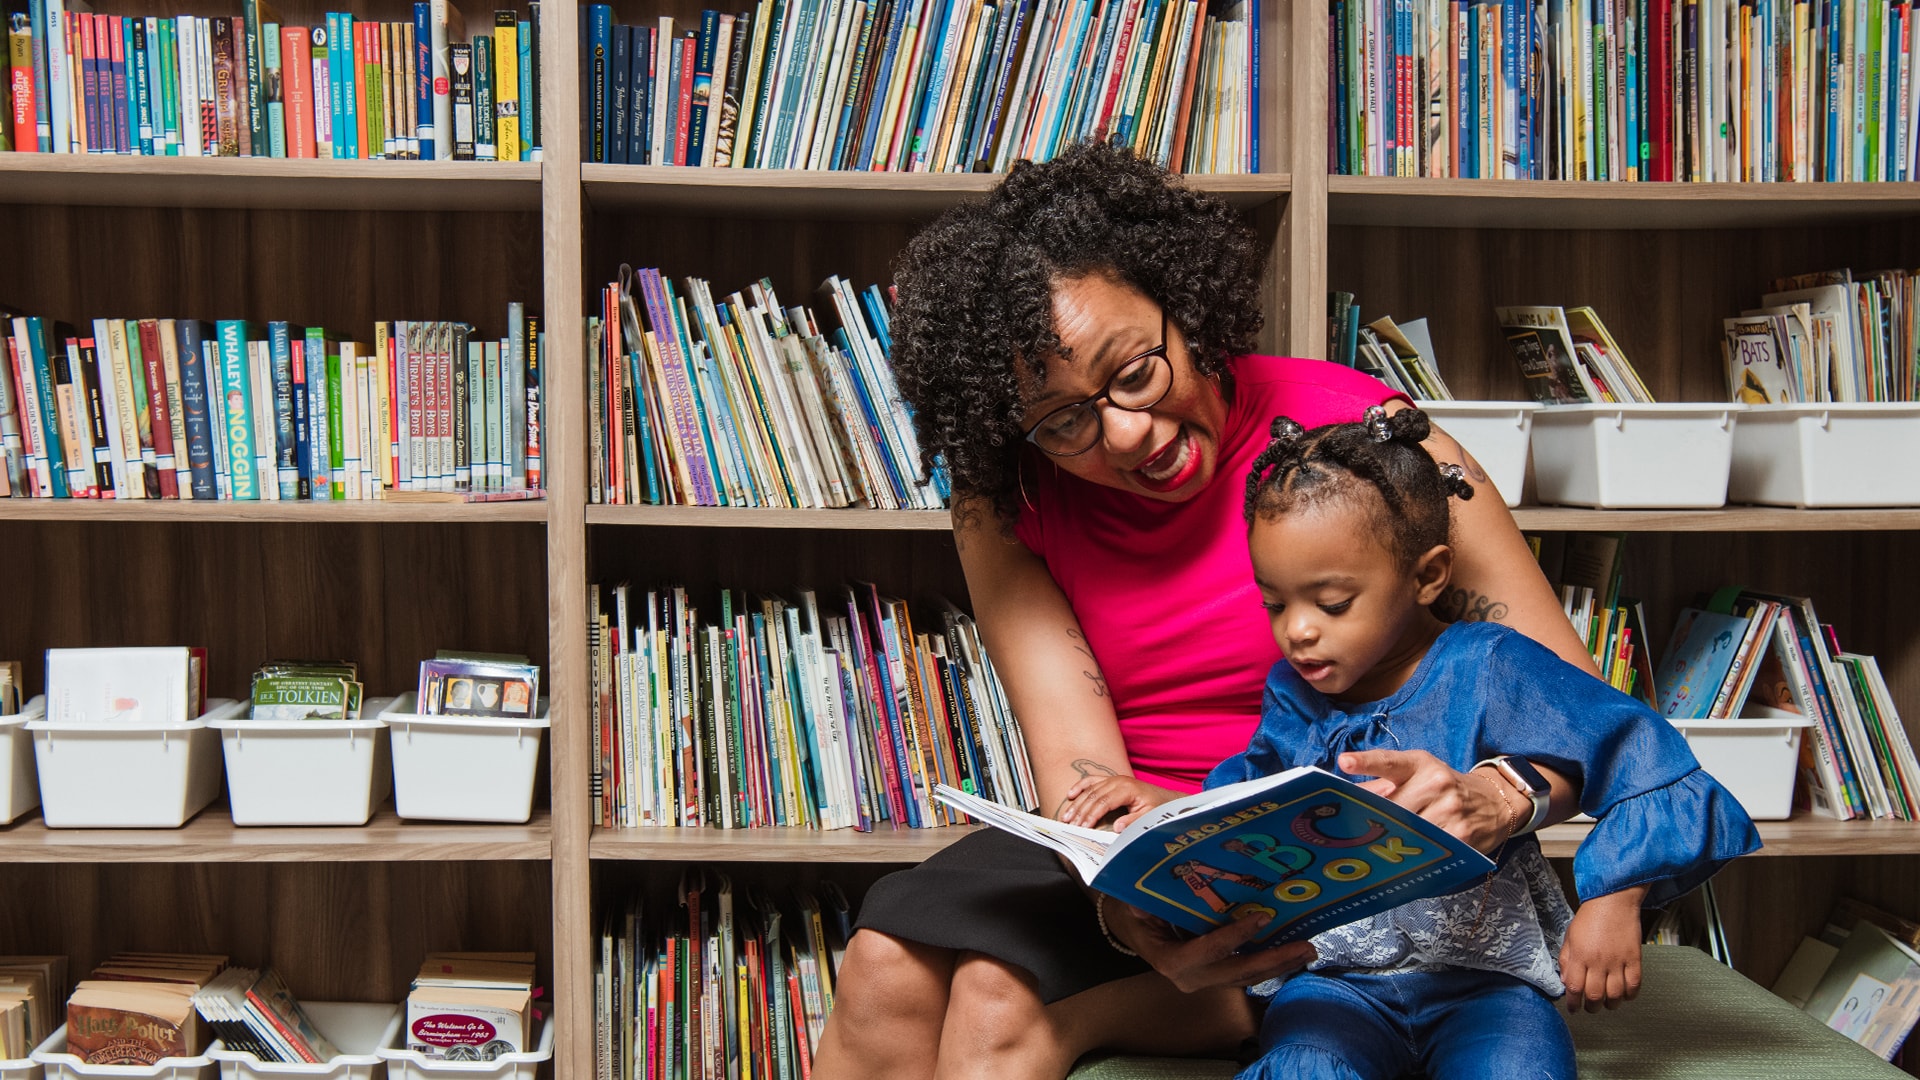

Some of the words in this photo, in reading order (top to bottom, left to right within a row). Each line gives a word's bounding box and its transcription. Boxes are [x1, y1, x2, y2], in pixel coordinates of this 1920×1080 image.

[17, 38, 27, 57] Ryan
[247, 34, 256, 56] Down
[735, 29, 747, 48] The
[860, 25, 872, 48] NOT
[1508, 33, 1514, 45] ON
[249, 59, 257, 67] in
[418, 42, 429, 71] Maniac
[730, 51, 742, 80] Giver
[86, 72, 95, 97] HOLES
[100, 71, 109, 96] HOLES
[115, 75, 124, 100] HOLES
[217, 70, 230, 112] GRIMM
[13, 70, 27, 124] augustine
[139, 89, 147, 105] TELL
[332, 82, 340, 115] STARGIRL
[345, 82, 353, 115] STARGIRL
[615, 86, 625, 109] Johnny
[633, 88, 643, 110] Johnny
[252, 109, 262, 132] Woods
[616, 110, 625, 134] Tremain
[634, 111, 643, 136] Tremain
[695, 109, 703, 125] JOAN
[271, 109, 280, 156] HORSERADIS
[275, 328, 287, 353] MAMA
[378, 328, 386, 348] Wilson
[529, 321, 537, 338] PAUL
[224, 325, 242, 389] WHALEY
[529, 342, 537, 369] ZINDEL
[658, 341, 671, 366] MISS
[1740, 339, 1770, 366] BATS
[25, 382, 34, 395] THE
[148, 361, 157, 390] Because
[153, 392, 161, 405] We
[277, 381, 289, 392] UP
[410, 355, 421, 406] MIRACLE'S
[425, 355, 436, 406] MIRACLE'S
[439, 355, 450, 406] MIRACLE'S
[27, 397, 37, 425] GOLDEN
[456, 385, 465, 438] Shimmershine
[664, 368, 687, 435] HUNNICUTT'S
[668, 341, 681, 366] MISS
[675, 368, 698, 436] HUNNICUTT'S
[692, 438, 704, 458] HAT
[171, 418, 183, 440] Child
[280, 411, 292, 433] MIND
[410, 409, 421, 435] BOYS
[425, 409, 436, 435] BOYS
[439, 409, 450, 435] BOYS
[30, 425, 41, 454] PASTURE
[319, 416, 328, 456] STRATEGIES
[682, 438, 694, 458] HAT
[229, 407, 251, 498] NOGGIN
[456, 440, 465, 466] Queens
[276, 689, 341, 704] TOLKIEN
[1718, 690, 1727, 704] OF
[707, 698, 715, 731] TWILIGHT
[724, 698, 732, 731] TWILIGHT
[891, 719, 901, 746] DREAM
[895, 746, 908, 780] MEADOW
[1164, 801, 1280, 855] AFRO-BETS
[470, 1031, 489, 1039] 1963
[91, 1046, 136, 1064] SORCERER'S
[140, 1048, 161, 1064] STON
